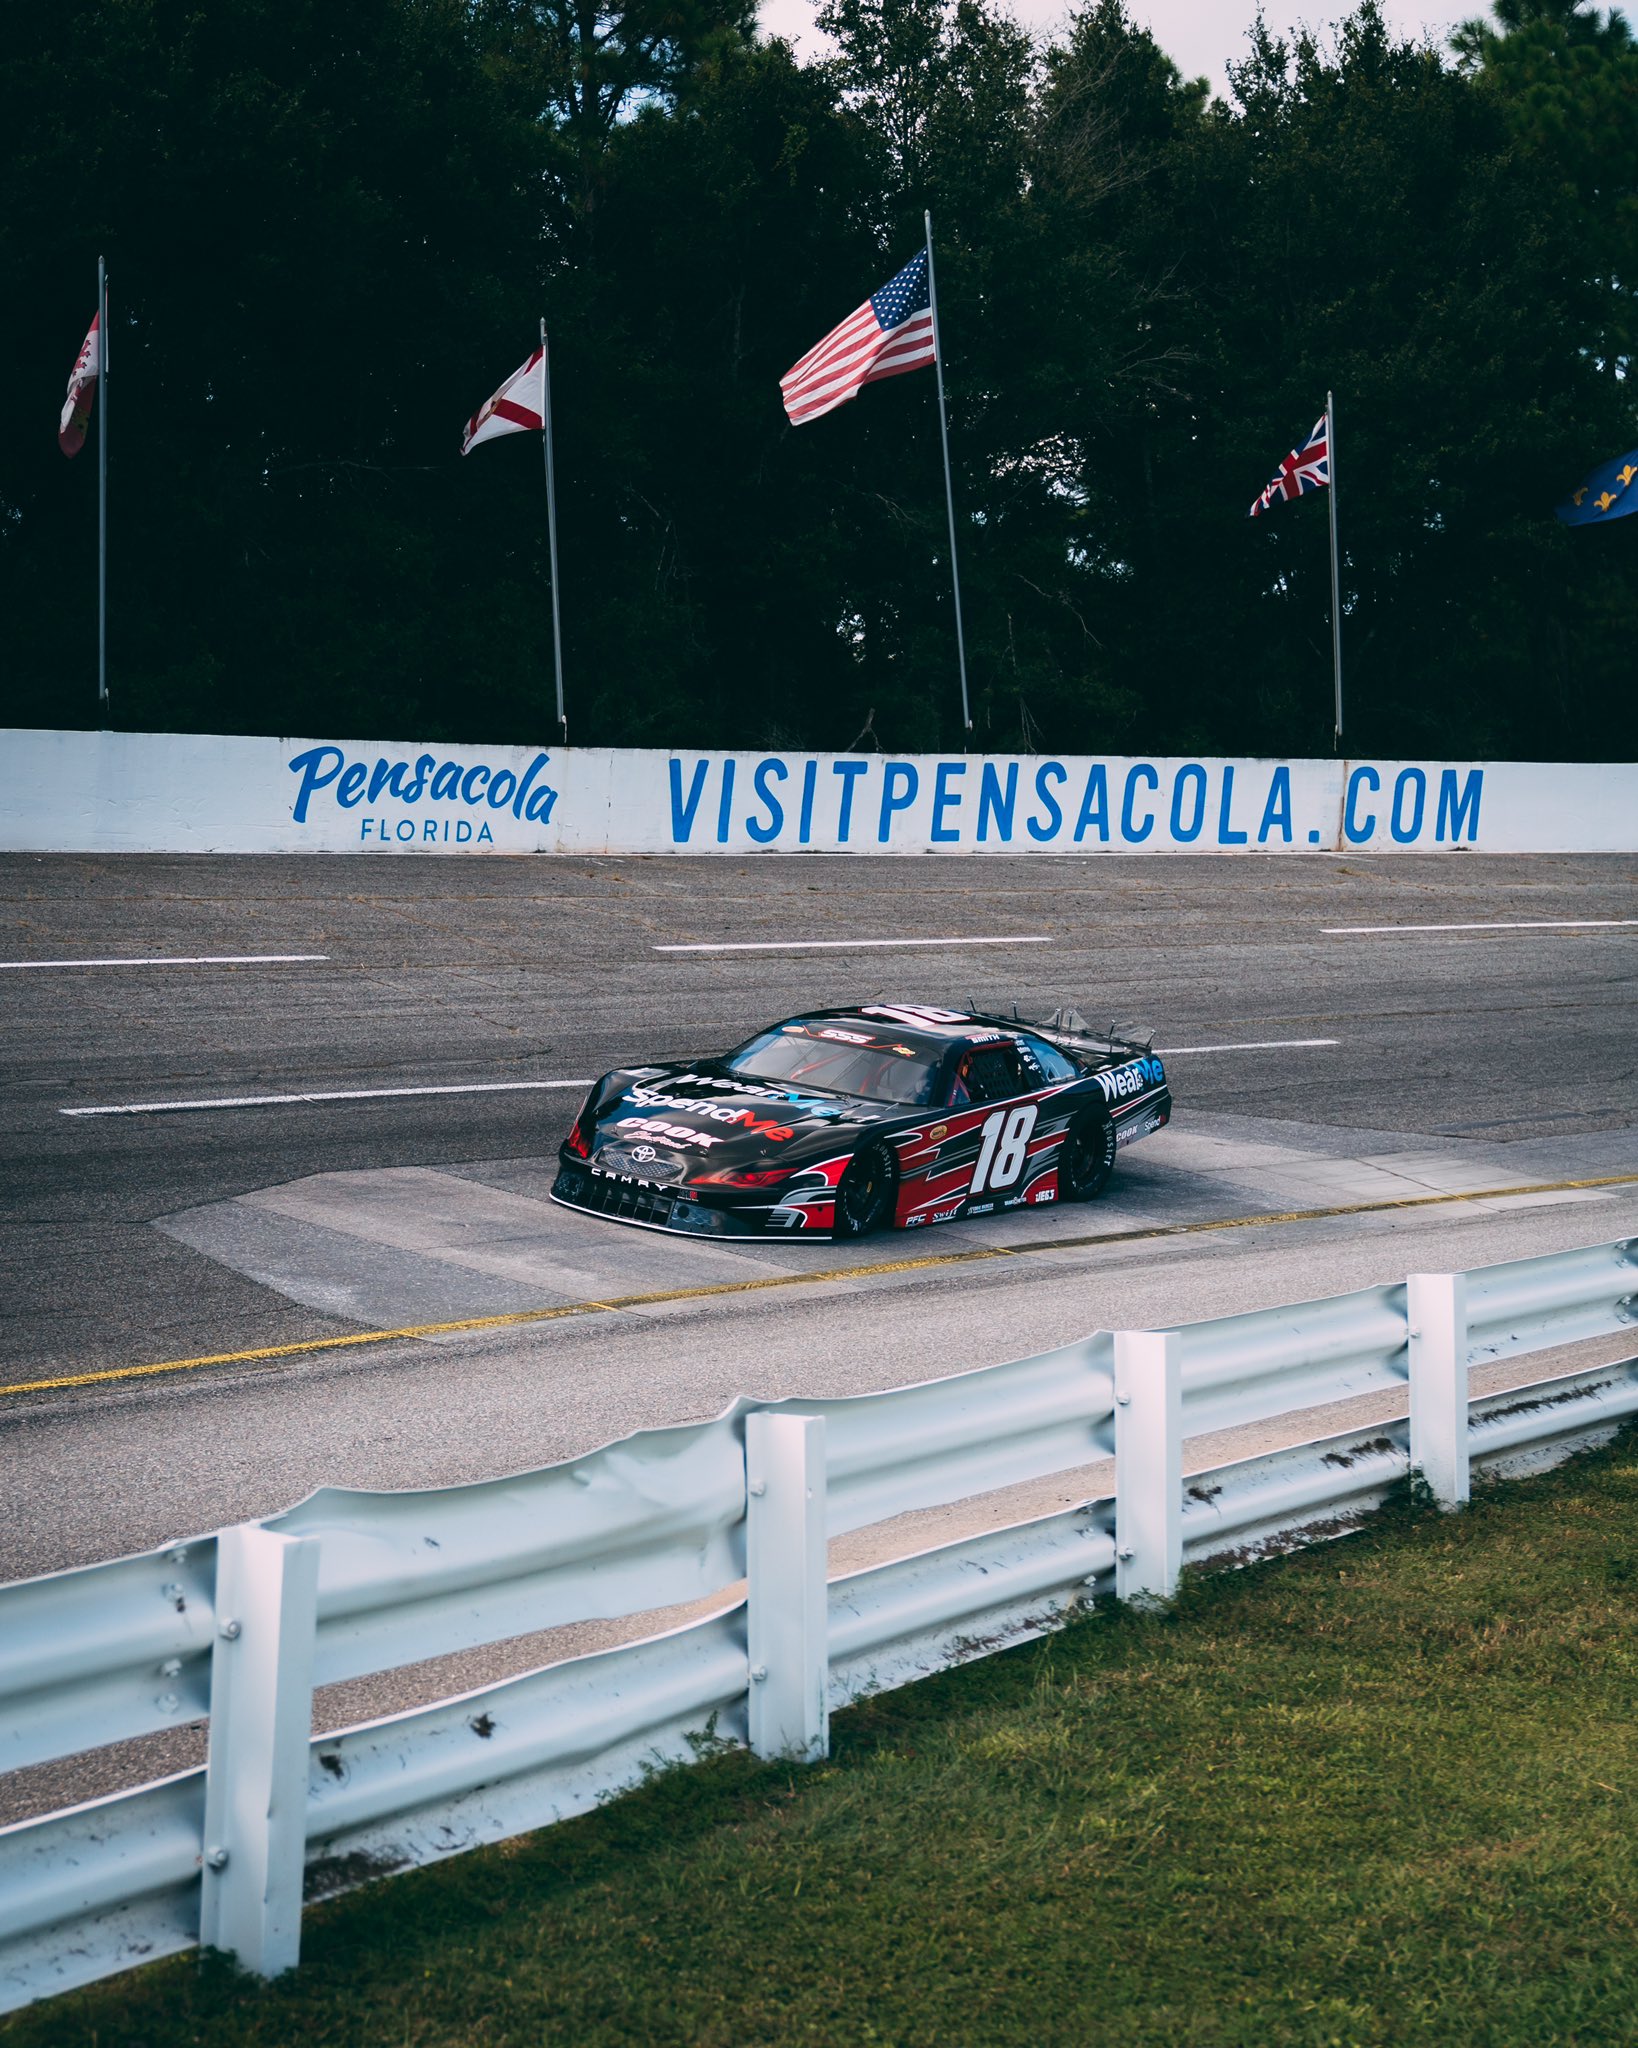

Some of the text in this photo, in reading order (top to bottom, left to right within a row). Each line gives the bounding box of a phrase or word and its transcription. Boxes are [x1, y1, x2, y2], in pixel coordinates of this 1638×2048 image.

[288, 746, 560, 824] Pensacola
[668, 757, 1485, 846] VISITPENSACOLA.COM
[361, 818, 494, 843] FLORIDA
[861, 1004, 972, 1028] 18
[675, 1074, 843, 1117] WearMe
[1093, 1059, 1164, 1102] WearMe
[616, 1117, 725, 1148] COOK
[622, 1087, 795, 1142] SpendMe
[969, 1104, 1039, 1194] 18
[591, 1168, 669, 1192] CAMRY
